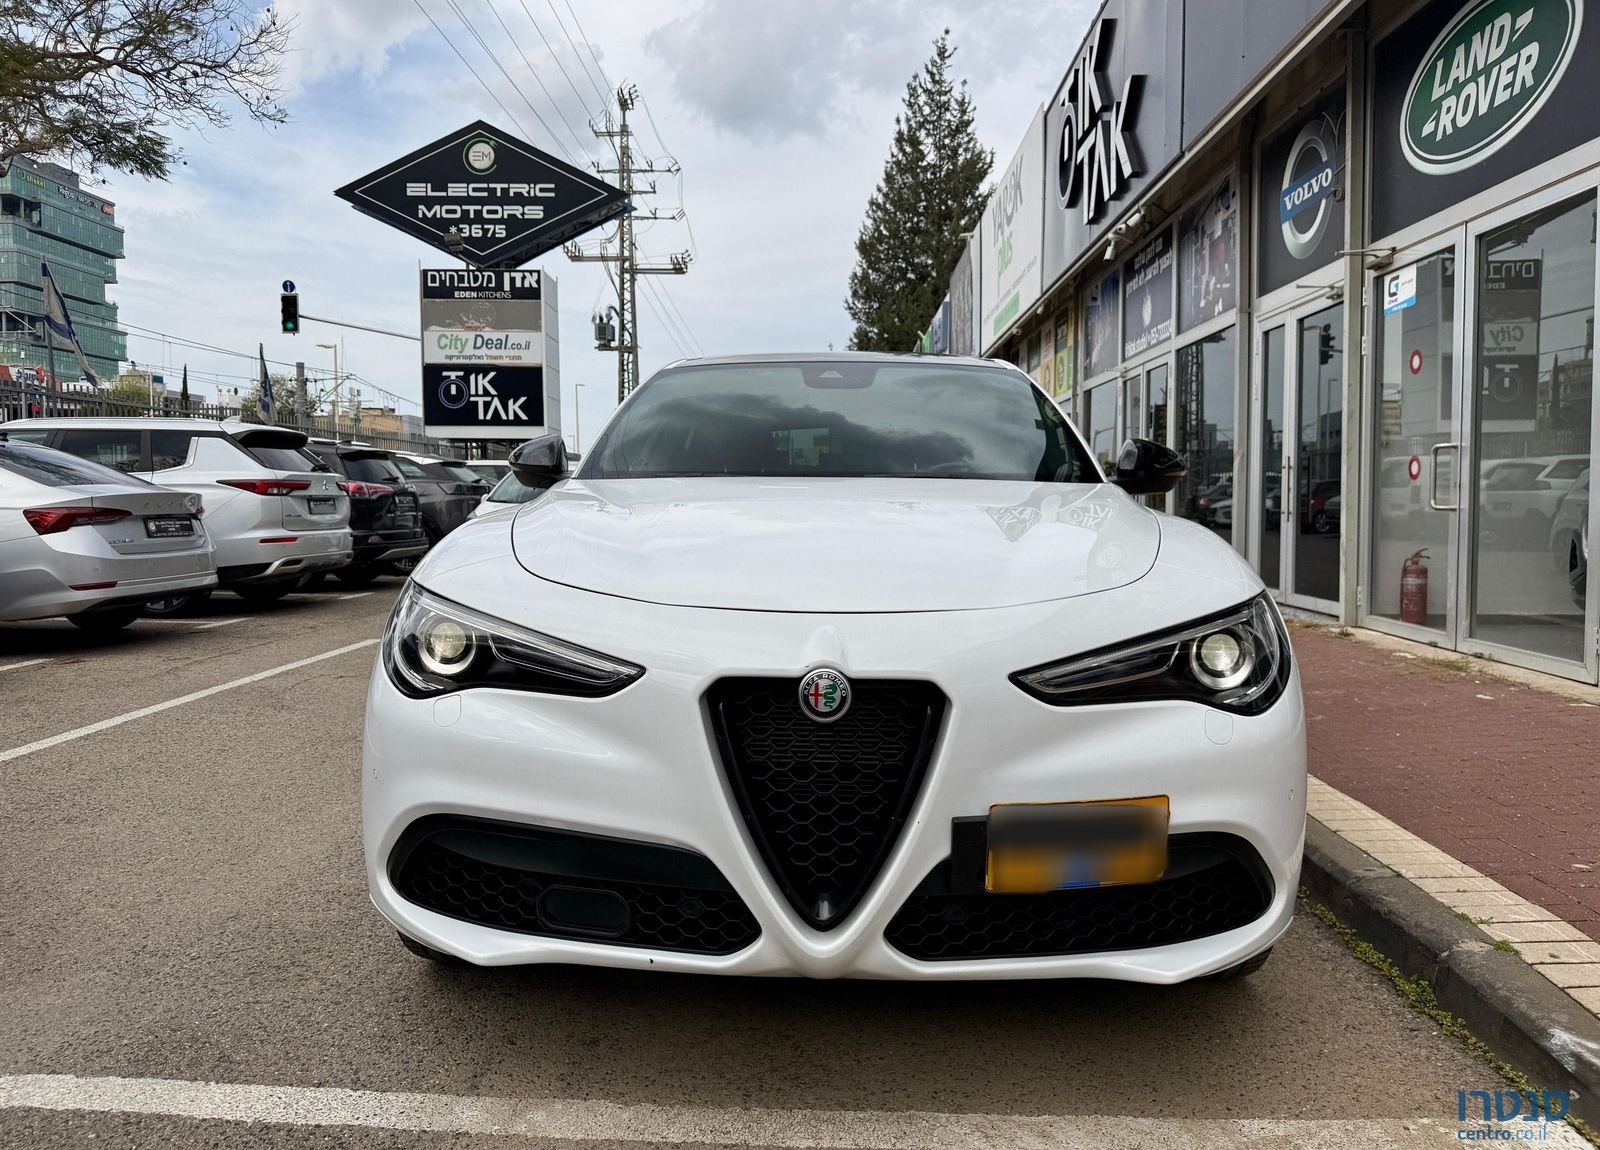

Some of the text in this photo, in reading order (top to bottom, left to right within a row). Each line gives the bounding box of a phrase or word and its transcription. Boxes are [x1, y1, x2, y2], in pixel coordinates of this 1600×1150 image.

[1076, 74, 1146, 226] TAK
[992, 154, 1024, 247] YAROK
[1283, 167, 1333, 212] VOLVO
[418, 205, 544, 219] MOTORS
[427, 270, 539, 291] אדן מטבחים
[478, 291, 512, 299] KITCHENS
[437, 333, 469, 353] City
[469, 396, 529, 421] TAK
[803, 673, 847, 697] ALFA ROMEO
